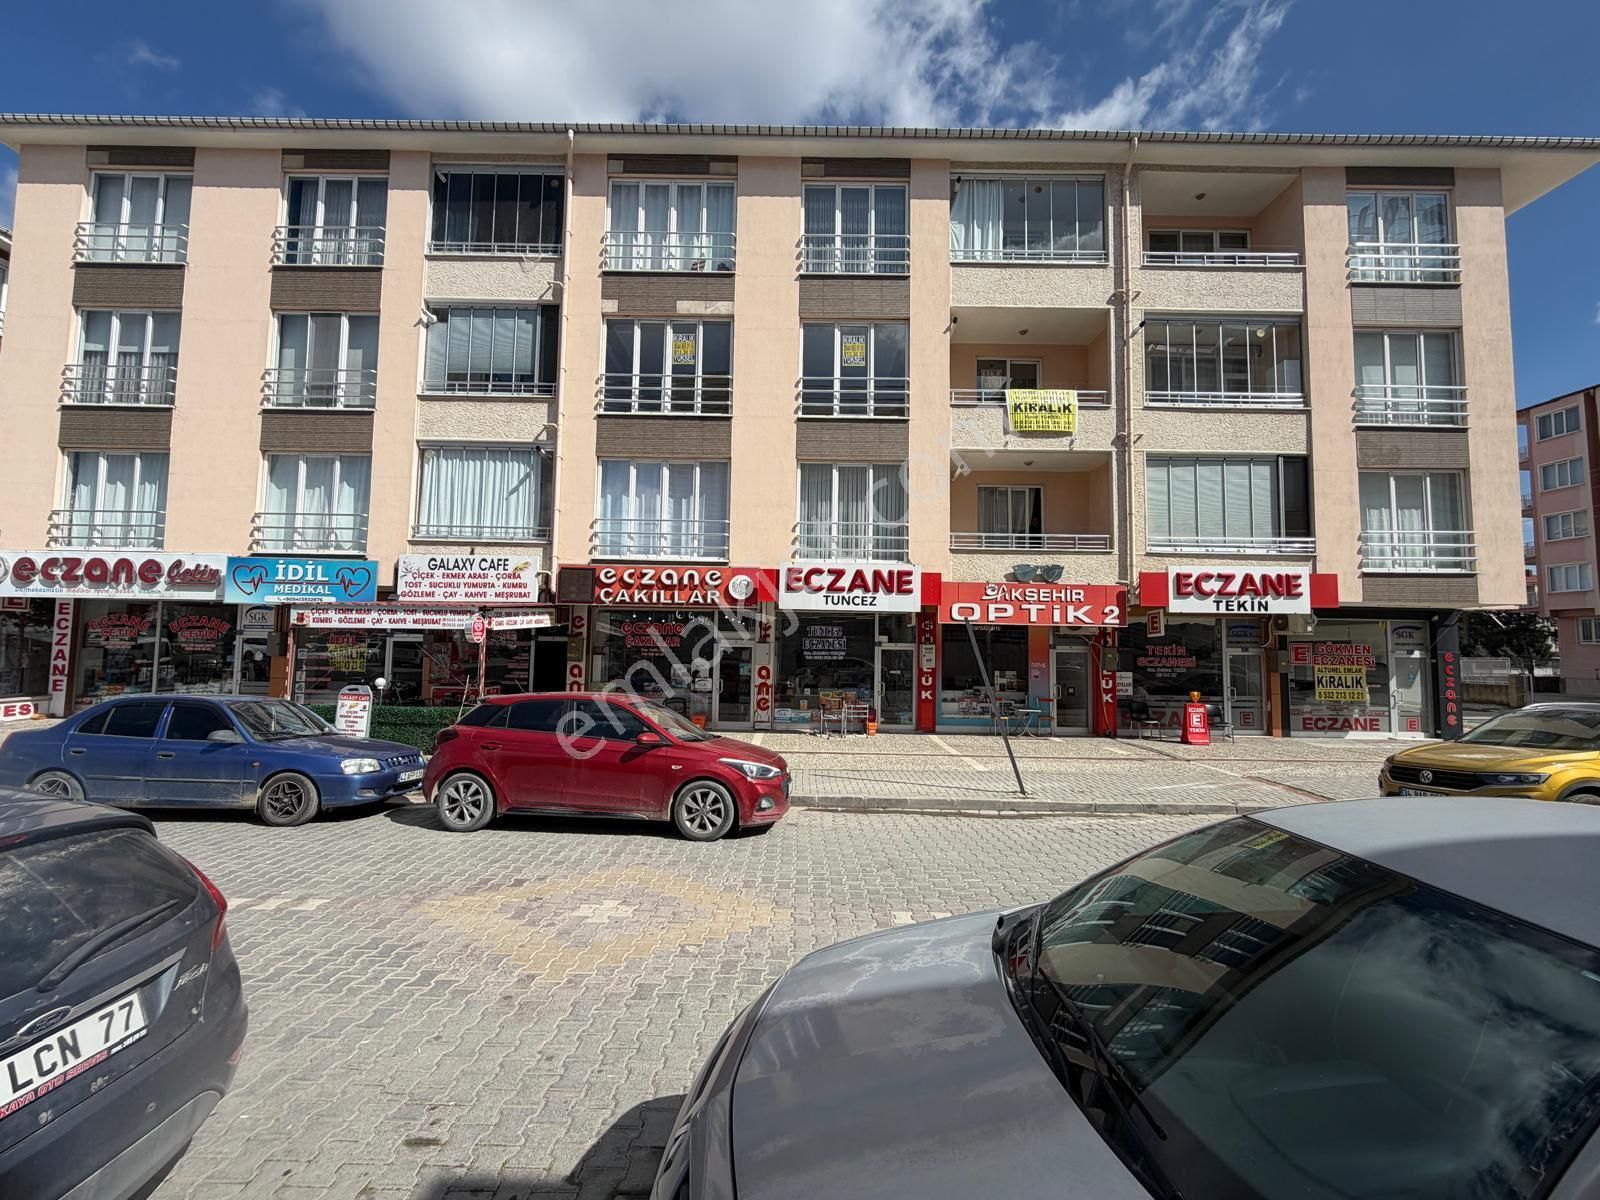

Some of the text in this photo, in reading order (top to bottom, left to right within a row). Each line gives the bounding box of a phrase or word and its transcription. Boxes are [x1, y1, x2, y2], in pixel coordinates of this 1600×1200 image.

[11, 556, 164, 584] eczane
[275, 560, 328, 582] İDİL
[427, 557, 509, 571] GALAXY CAFE
[411, 571, 435, 580] ÇİÇEK
[495, 573, 521, 581] ÇORBA
[599, 568, 722, 586] eczane
[784, 567, 914, 595] ECZANE
[273, 583, 331, 594] MEDİKAL
[404, 581, 422, 589] TOST
[1174, 572, 1304, 598] ECZANE
[400, 590, 436, 598] GÖZLEME
[442, 592, 458, 600] ÇAY
[494, 592, 531, 600] MEŞRUBAT
[600, 588, 720, 605] ÇAKILLAR
[996, 584, 1084, 603] AKŞEHİR
[823, 596, 877, 606] TUNCEZ
[1213, 598, 1269, 611] TEKİN
[248, 611, 268, 622] SGK
[338, 616, 366, 624] GÖZLEME
[371, 617, 383, 626] ÇAY
[412, 618, 441, 627] MEŞRUBAT
[1103, 606, 1120, 624] 2
[88, 613, 150, 632] ECZANE
[168, 615, 231, 633] ECZANE
[621, 622, 685, 635] eczane
[100, 626, 138, 639] ÇETİN
[181, 627, 218, 642] ÇETİN
[1395, 631, 1415, 640] SGK
[51, 602, 71, 692] ECZANE
[625, 636, 681, 648] ÇAKILLAR
[1315, 641, 1371, 655] GÖKMEN
[1145, 643, 1186, 656] TEKİN
[1318, 691, 1364, 699] 0 532 213 12 21
[1443, 651, 1457, 727] eczane
[1302, 717, 1380, 731] ECZANE
[7, 1029, 82, 1094] LCN
[98, 1000, 135, 1045] 77
[38, 1077, 65, 1098] OTO
